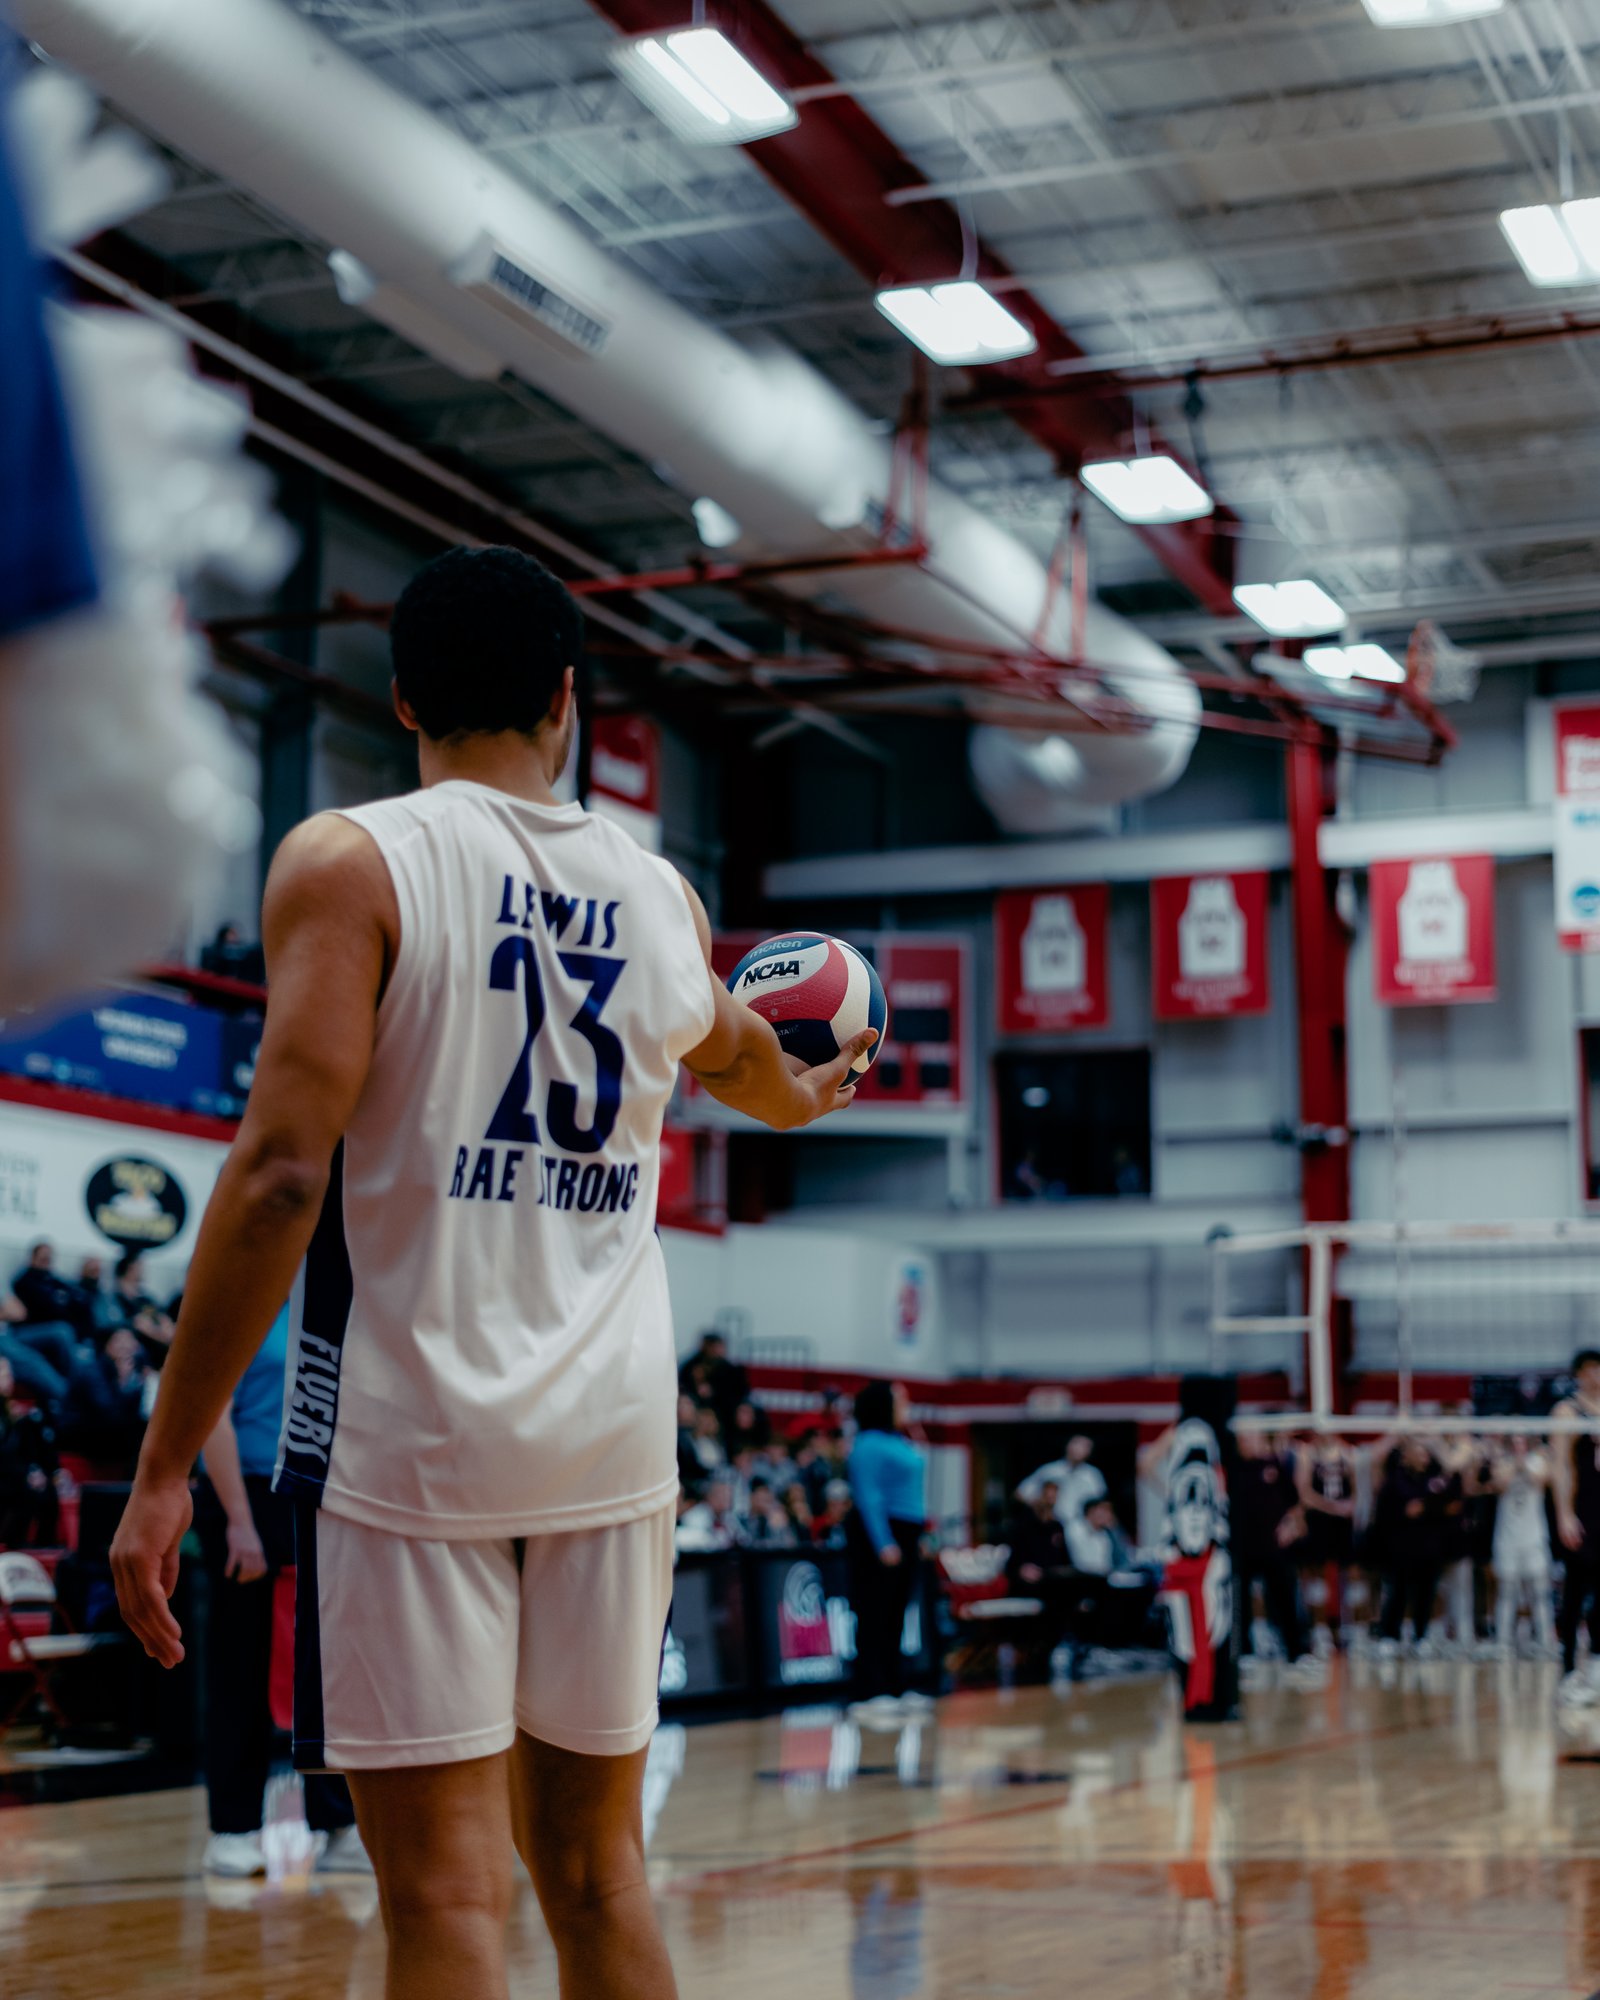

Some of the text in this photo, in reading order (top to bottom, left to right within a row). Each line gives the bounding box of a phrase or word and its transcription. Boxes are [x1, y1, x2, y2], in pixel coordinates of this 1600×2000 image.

[496, 874, 621, 949] LEWIS
[743, 960, 799, 987] NCAA
[750, 940, 802, 958] molten
[484, 935, 628, 1152] 23
[448, 1145, 638, 1212] RAE TRONG
[286, 1329, 341, 1464] FLYERS
